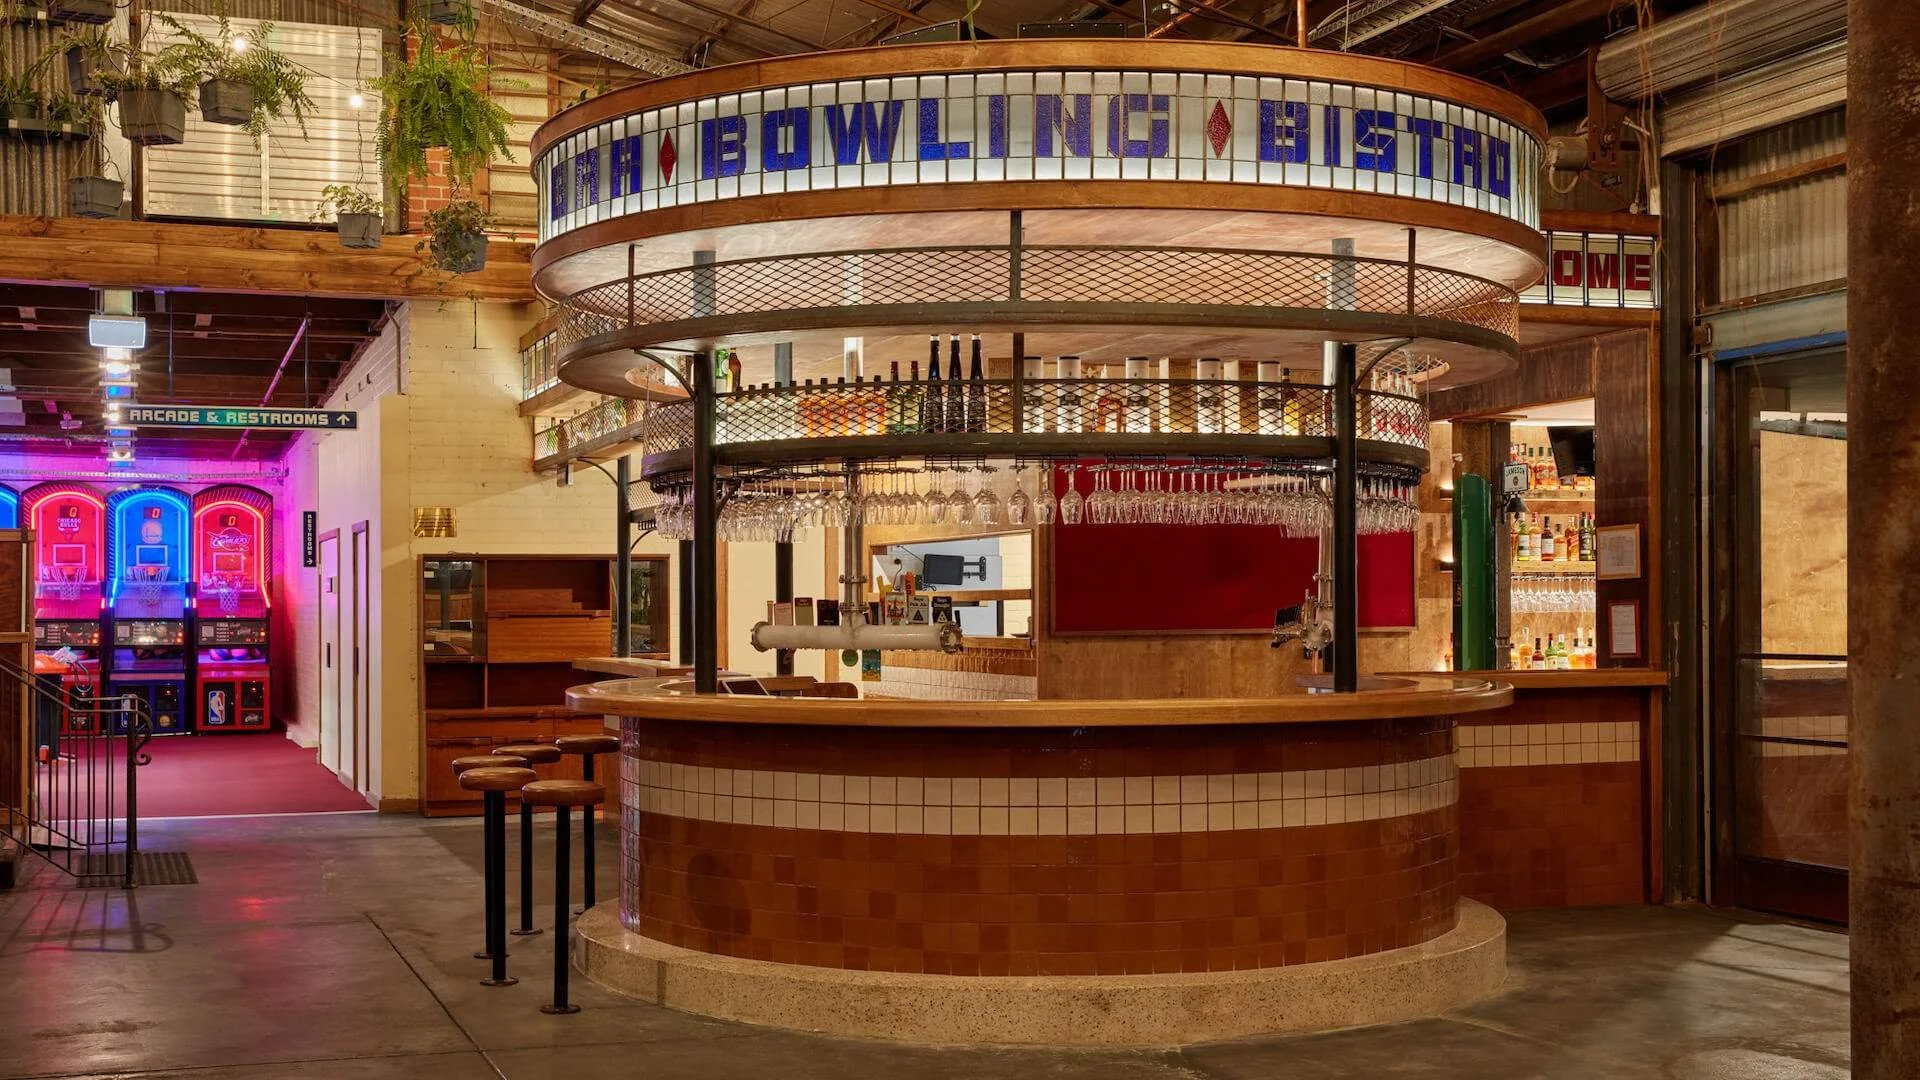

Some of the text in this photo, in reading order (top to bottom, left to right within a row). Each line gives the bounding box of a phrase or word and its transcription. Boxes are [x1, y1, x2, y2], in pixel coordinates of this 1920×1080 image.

[552, 94, 1510, 221] BAR BOWLING BISTRO
[1534, 250, 1652, 290] OME
[129, 410, 329, 425] ARCADE & RESTROOMS
[1505, 466, 1525, 477] JAMESON
